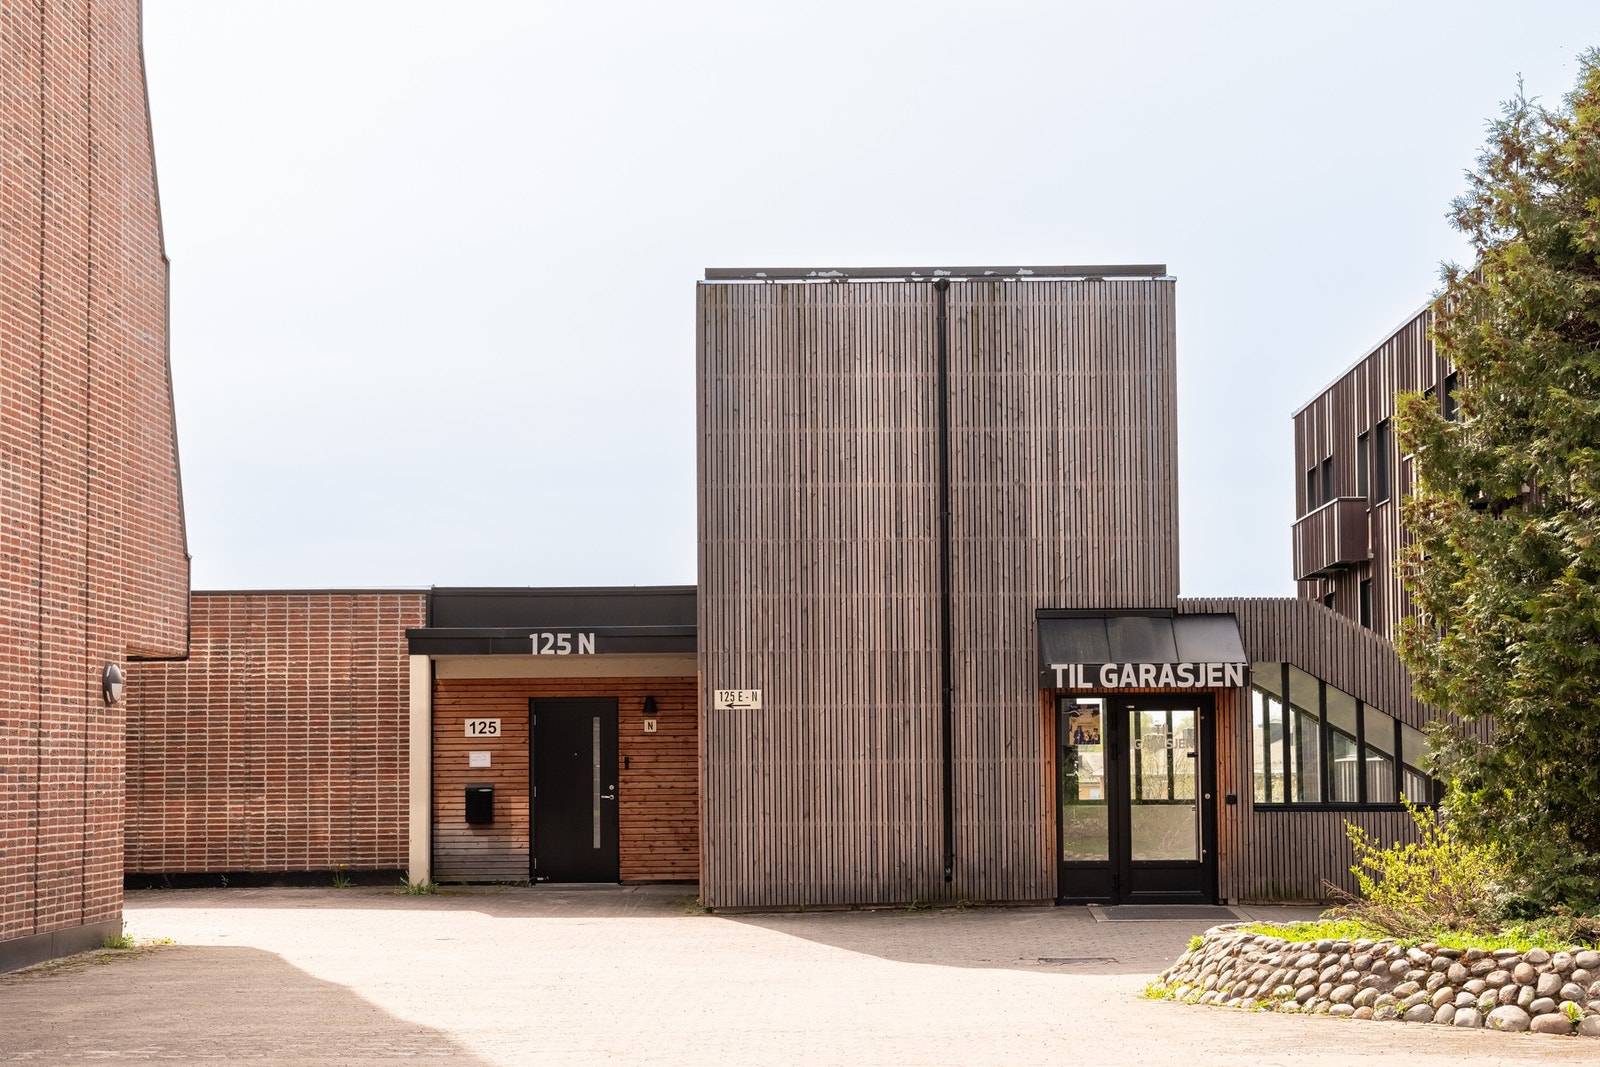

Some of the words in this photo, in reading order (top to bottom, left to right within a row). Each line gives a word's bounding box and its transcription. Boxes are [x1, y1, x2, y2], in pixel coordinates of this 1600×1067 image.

[529, 632, 572, 656] 125
[578, 632, 595, 655] N
[1051, 663, 1093, 688] TIL
[1099, 662, 1244, 688] GARASJEN
[718, 691, 735, 702] 125
[469, 721, 497, 735] 125
[647, 721, 654, 731] N
